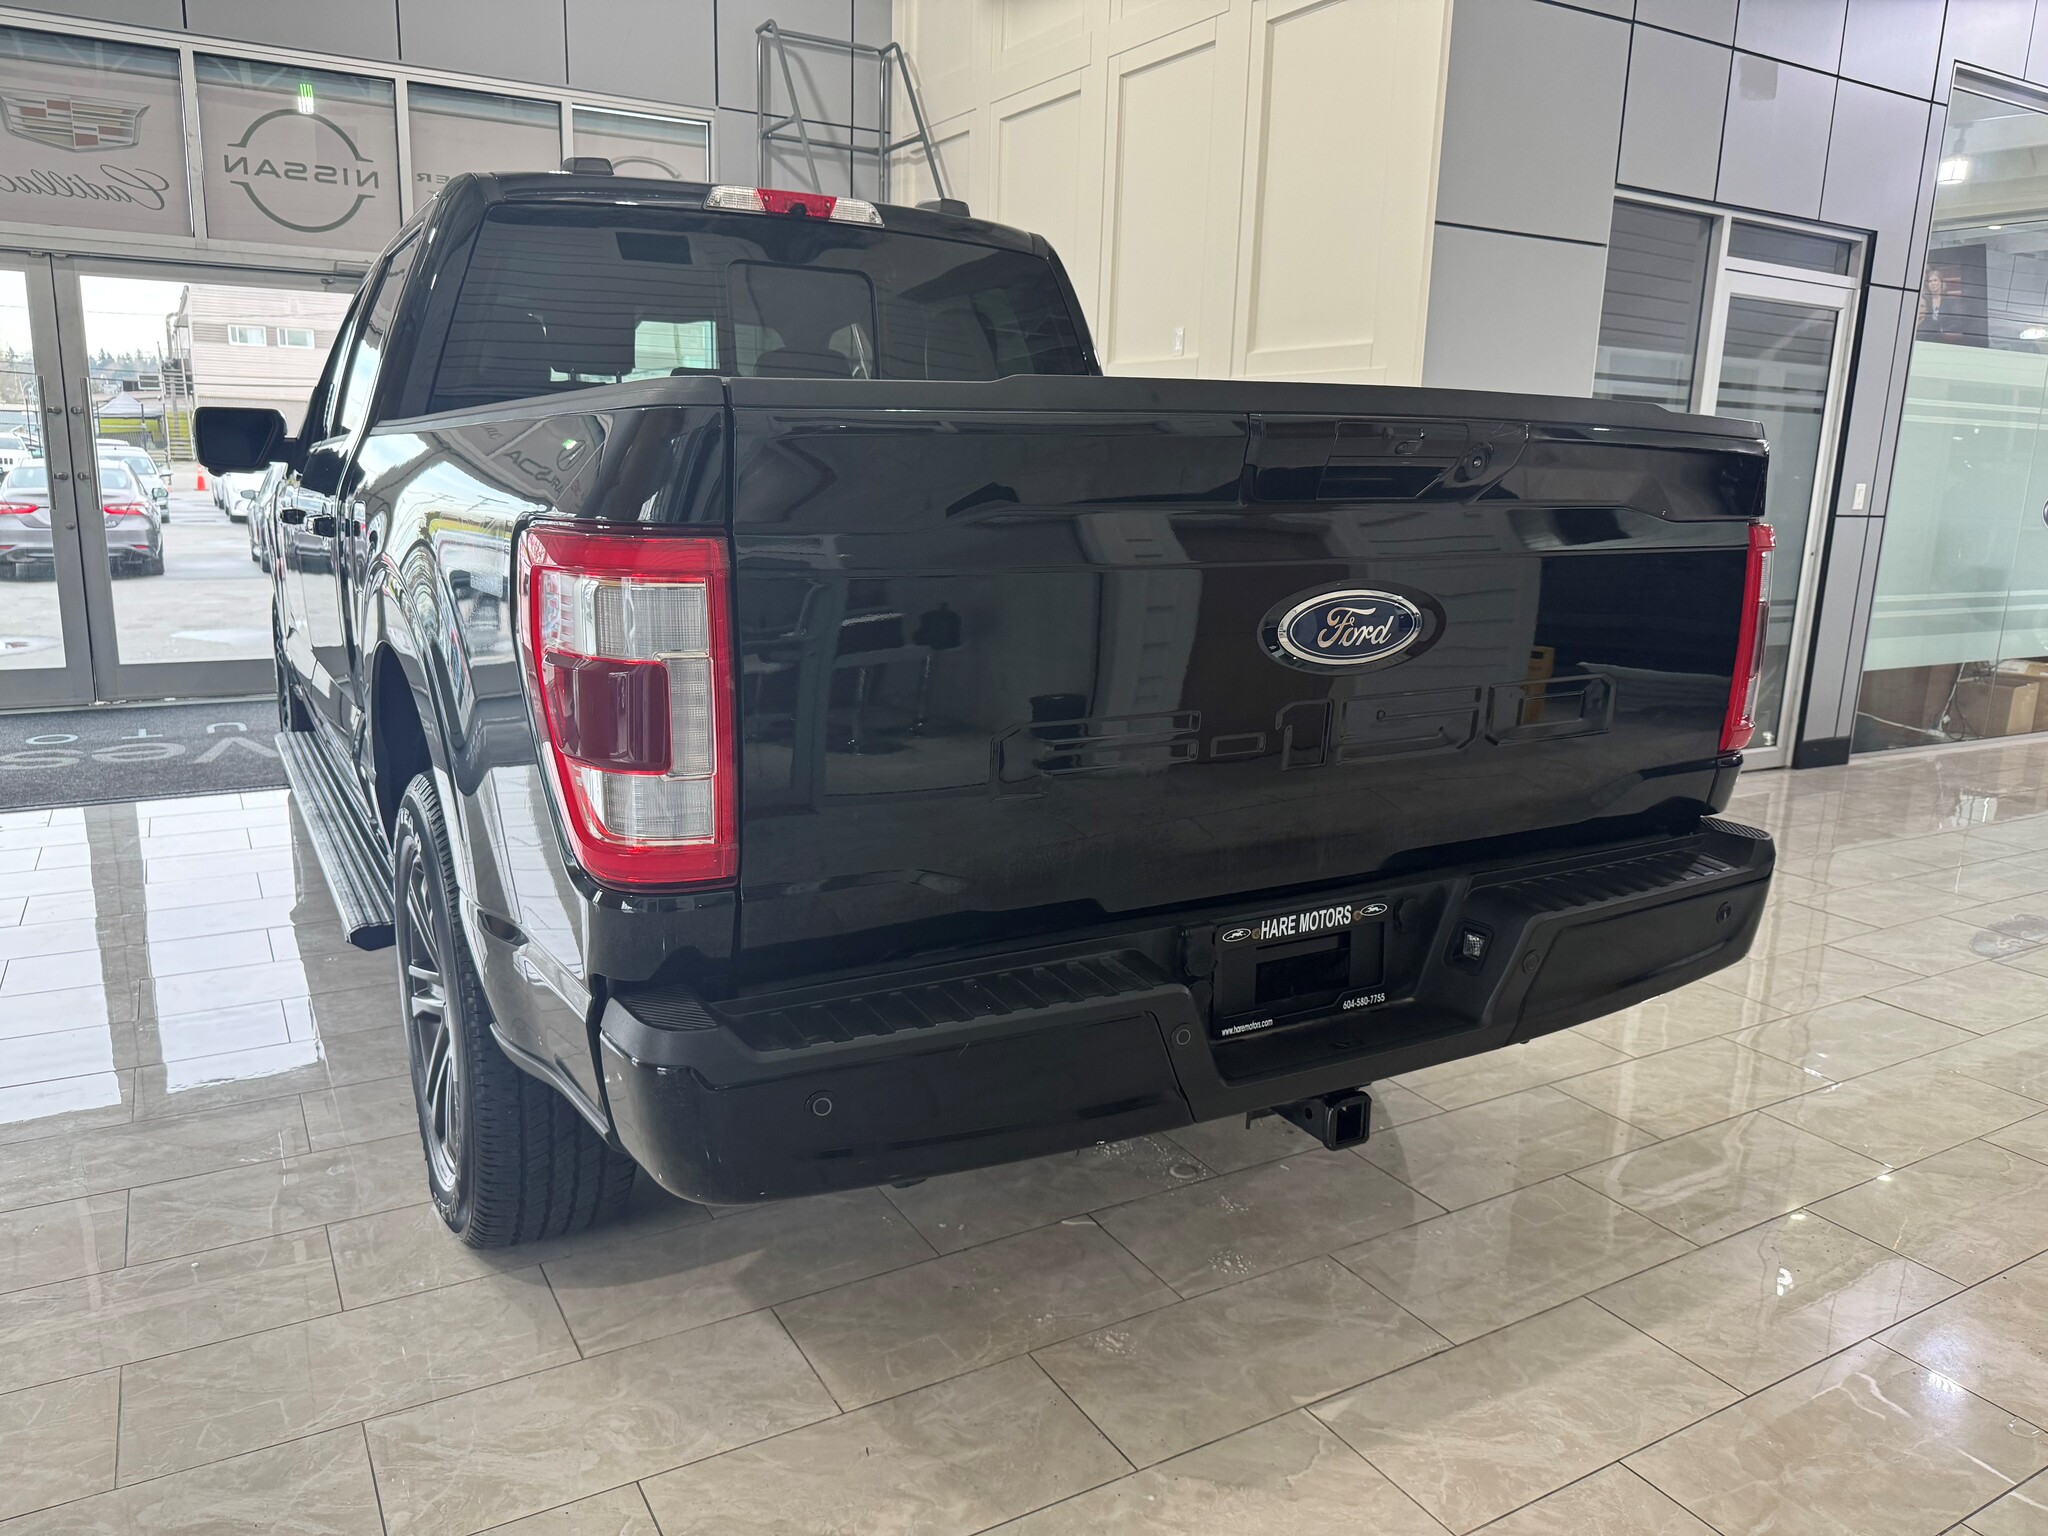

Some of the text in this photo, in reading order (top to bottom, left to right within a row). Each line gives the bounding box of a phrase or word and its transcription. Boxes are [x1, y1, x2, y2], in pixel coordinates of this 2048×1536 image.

[1317, 607, 1394, 648] Ford
[991, 673, 1617, 800] F-150
[1260, 905, 1352, 940] HARE MOTORS
[1342, 992, 1386, 1010] 604-580-7755
